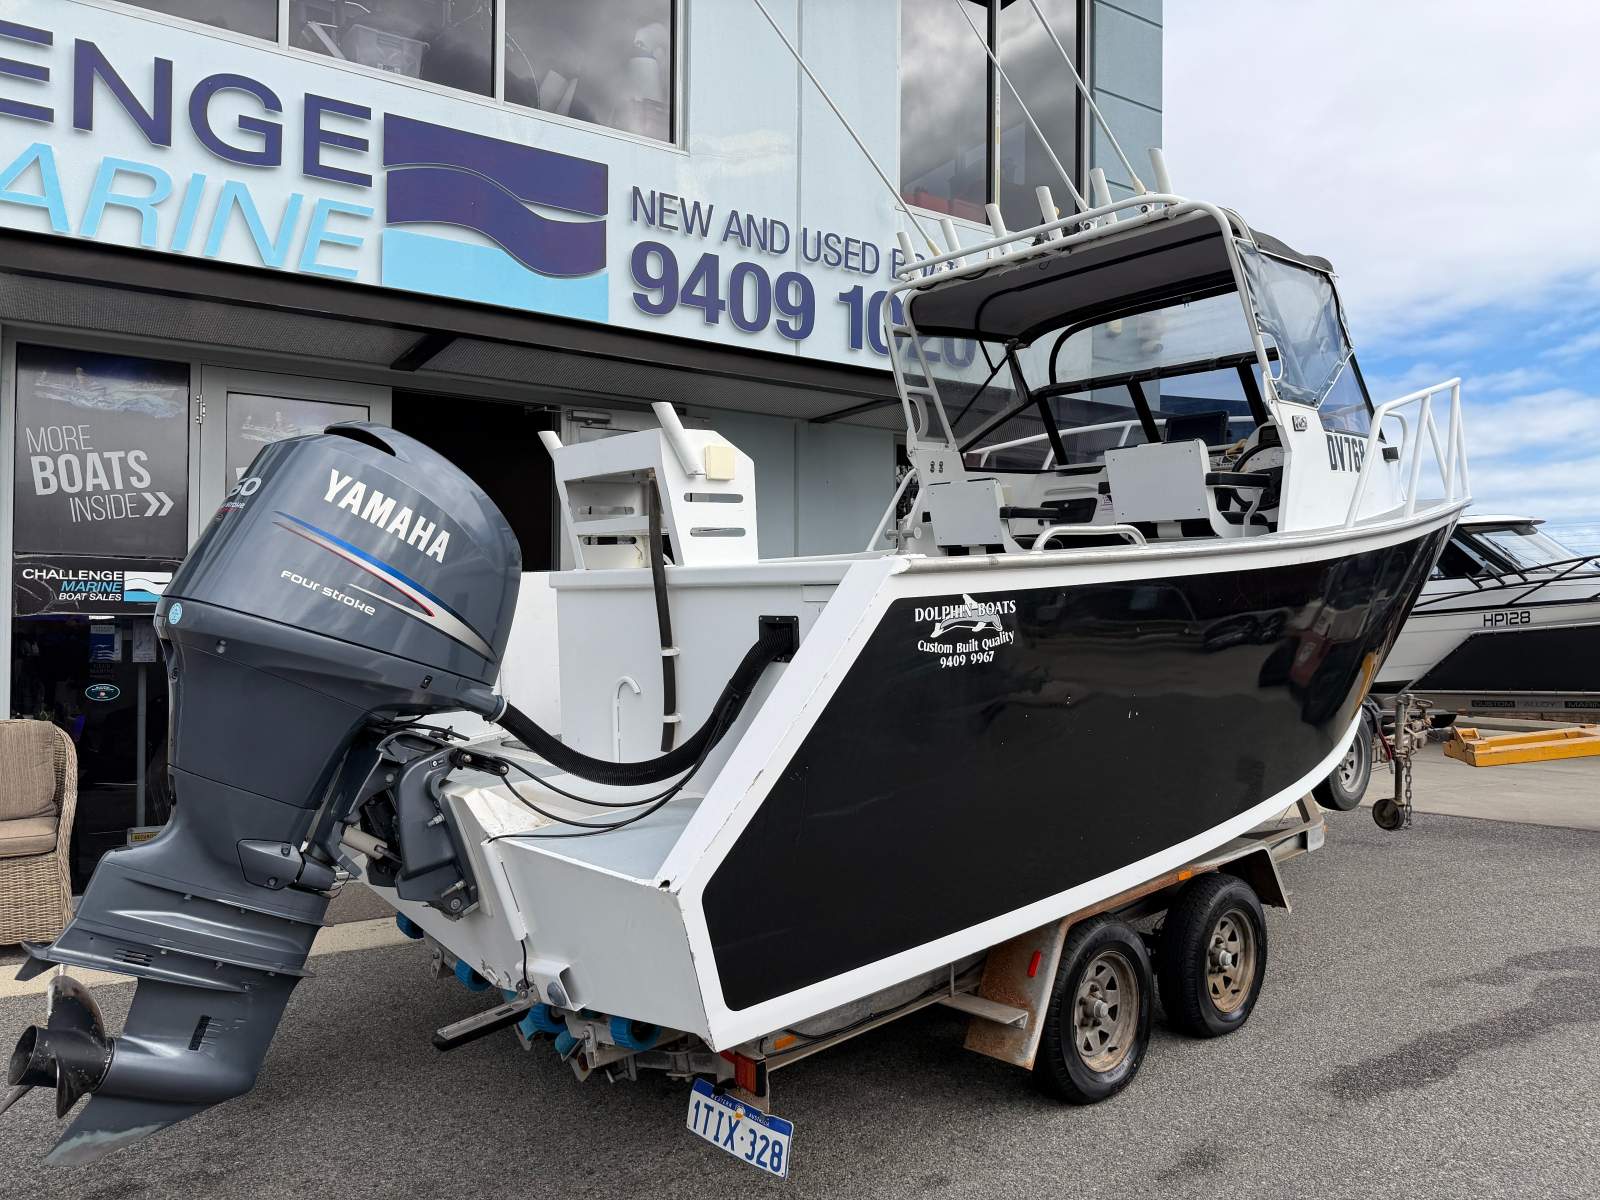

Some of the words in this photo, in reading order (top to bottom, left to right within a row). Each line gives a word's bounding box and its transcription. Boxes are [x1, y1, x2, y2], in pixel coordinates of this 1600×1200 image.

[0, 142, 374, 280] ARINE
[632, 185, 714, 238] NEW
[722, 209, 790, 255] AND
[803, 227, 881, 275] USED
[631, 240, 817, 341] 9409
[26, 425, 93, 453] MORE
[30, 450, 151, 496] BOATS
[69, 493, 140, 523] INSIDE
[324, 469, 451, 564] YAMAHA
[22, 568, 123, 581] CHALLENGE
[60, 580, 123, 593] MARINE
[58, 592, 86, 601] BOAT
[88, 592, 122, 601] SALES
[914, 603, 973, 622] DOLPHIN
[977, 599, 1017, 616] BOATS
[1483, 611, 1531, 628] HP128
[917, 640, 953, 654] Custom
[956, 638, 979, 653] Built
[981, 630, 1015, 650] Quality
[939, 654, 966, 668] 9409
[970, 650, 995, 665] 9967
